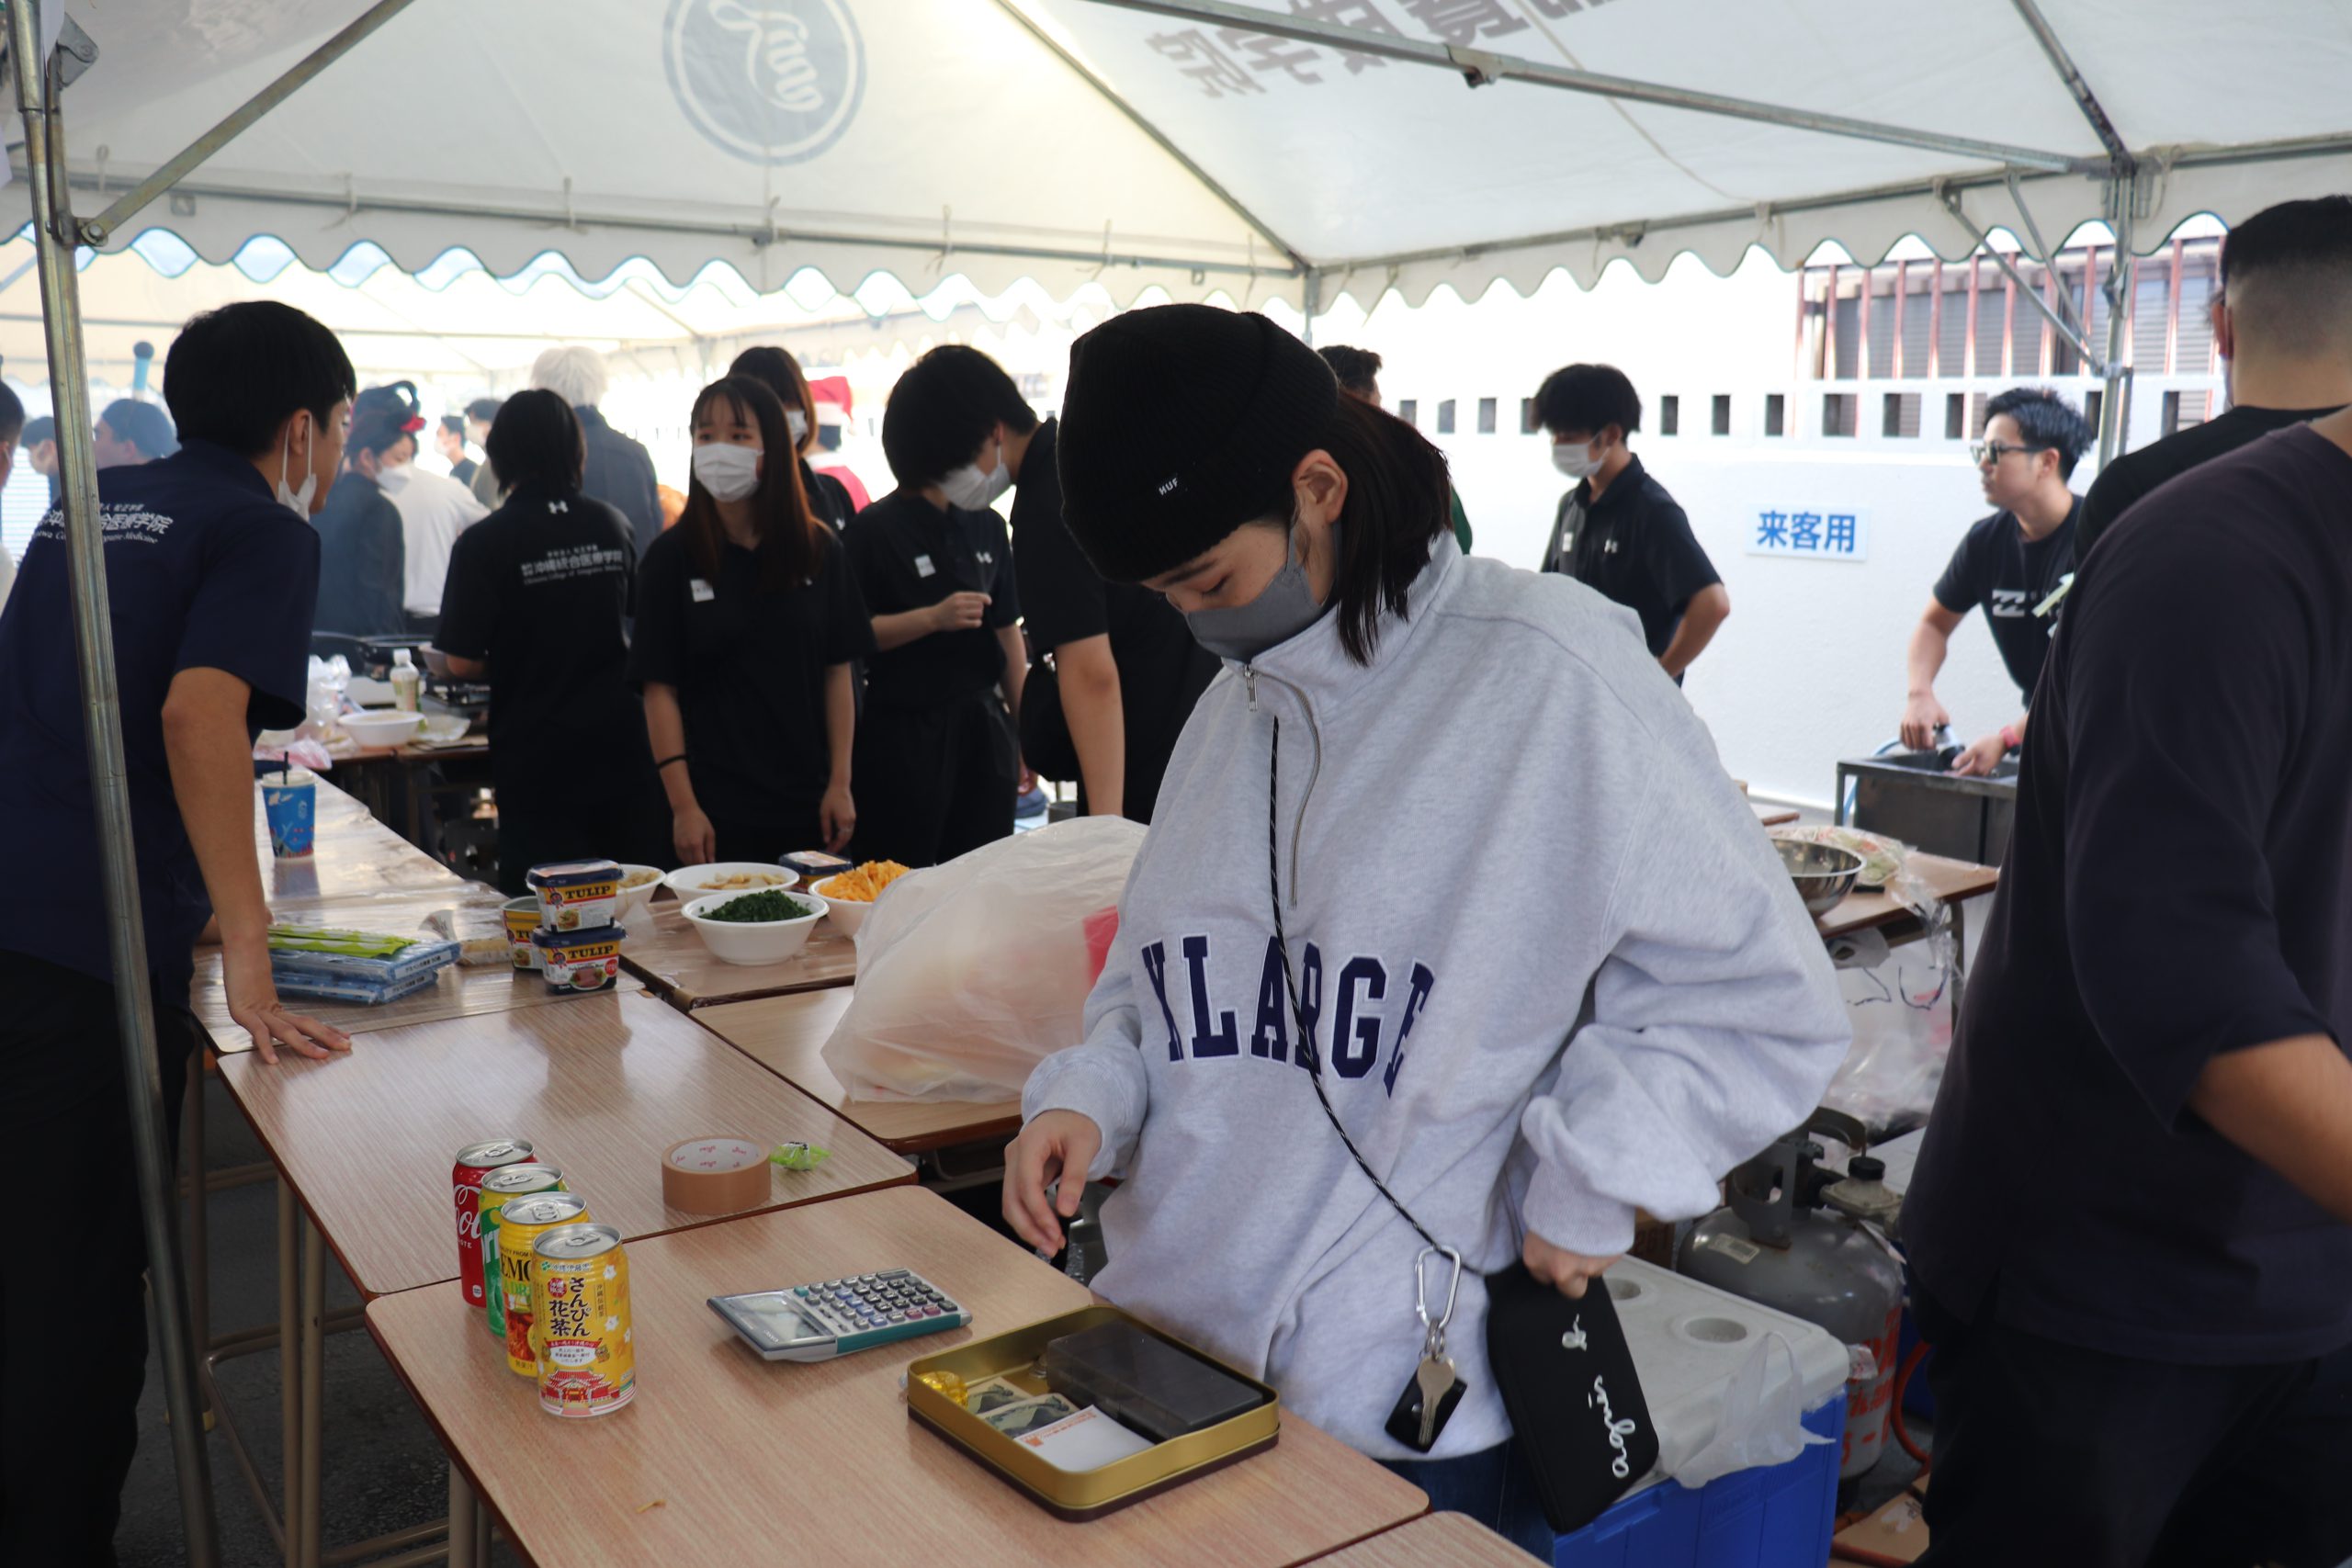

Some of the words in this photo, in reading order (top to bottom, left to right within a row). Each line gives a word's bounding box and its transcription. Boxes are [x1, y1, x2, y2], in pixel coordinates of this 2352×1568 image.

[1159, 478, 1177, 495] HUF
[1757, 511, 1855, 553] 来客用
[565, 885, 611, 899] TULIP
[568, 944, 614, 959] TULIP
[548, 1300, 571, 1337] 花茶
[570, 1277, 591, 1337] さんぴん
